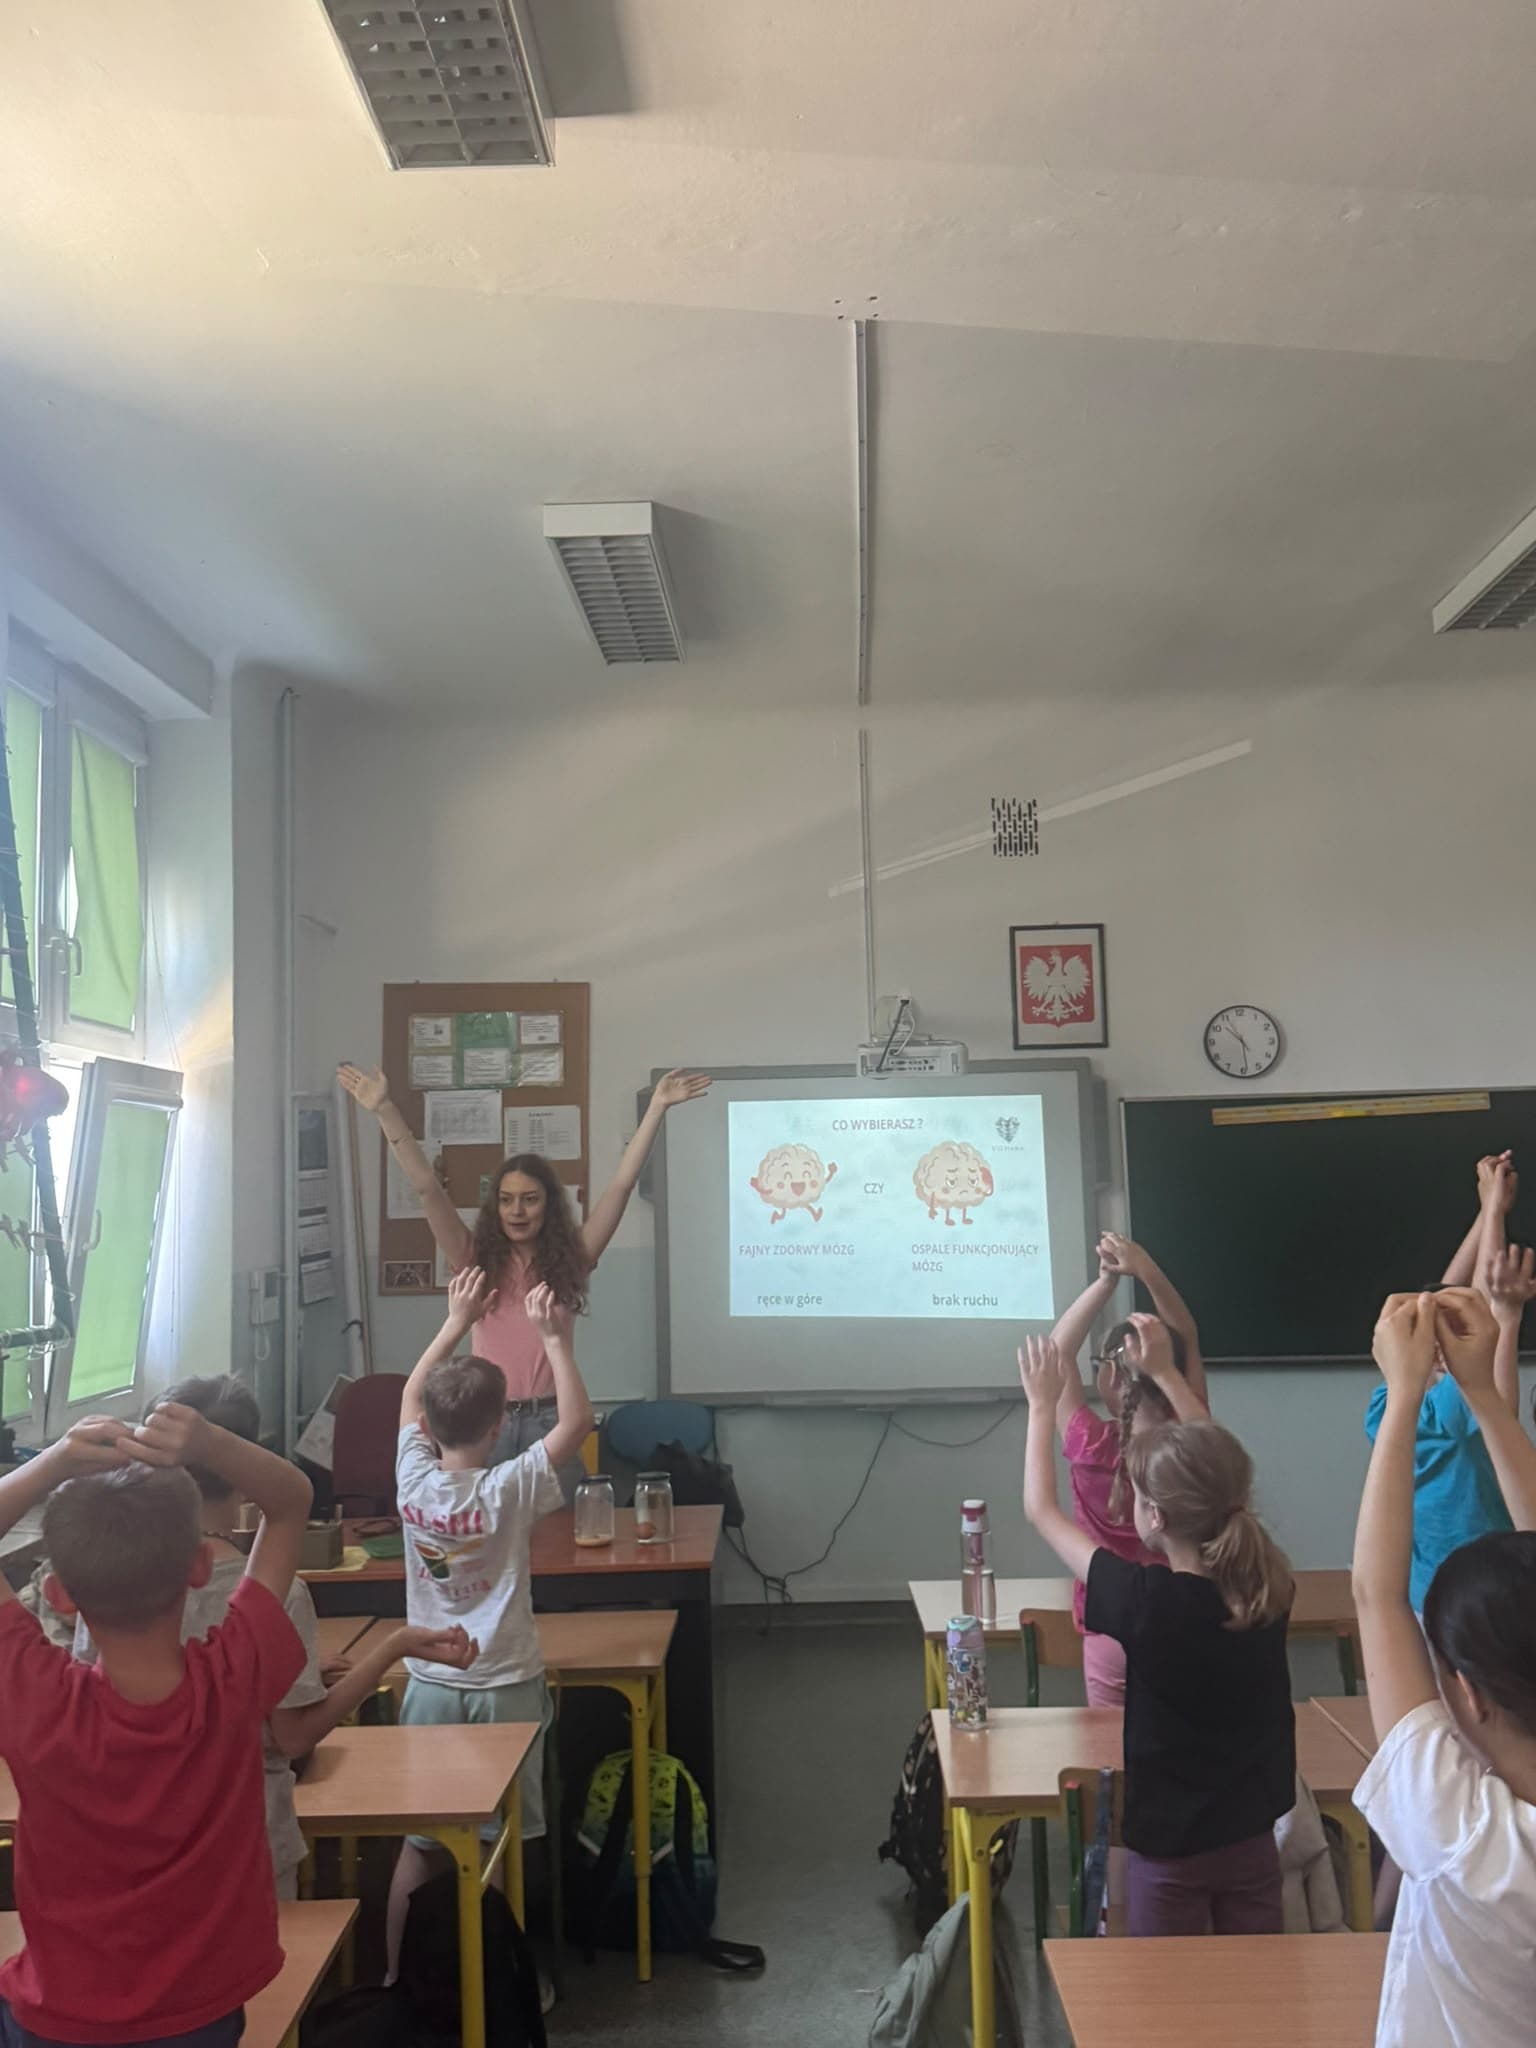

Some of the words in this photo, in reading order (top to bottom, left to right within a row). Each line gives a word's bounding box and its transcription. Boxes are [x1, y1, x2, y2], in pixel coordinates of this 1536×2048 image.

[1235, 1008, 1245, 1017] 12
[1213, 1025, 1222, 1033] 10
[1263, 1023, 1271, 1031] 2
[1208, 1038, 1216, 1047] 9
[1268, 1037, 1275, 1046] 3
[1225, 1063, 1231, 1071] 7
[832, 1119, 848, 1130] CO
[851, 1119, 915, 1130] WYBIERASZ
[917, 1118, 924, 1129] ?
[864, 1182, 884, 1194] CZY
[739, 1245, 771, 1257] FAJNY
[773, 1244, 819, 1256] ZDORWY
[822, 1242, 855, 1256] MÓZG
[952, 1244, 1039, 1257] FUNKCJONUJĄCY
[912, 1260, 944, 1273] MÓZG
[757, 1294, 782, 1308] ręce
[784, 1294, 794, 1305] w
[796, 1292, 823, 1308] góre
[932, 1292, 960, 1306] brak
[963, 1292, 998, 1307] ruchu
